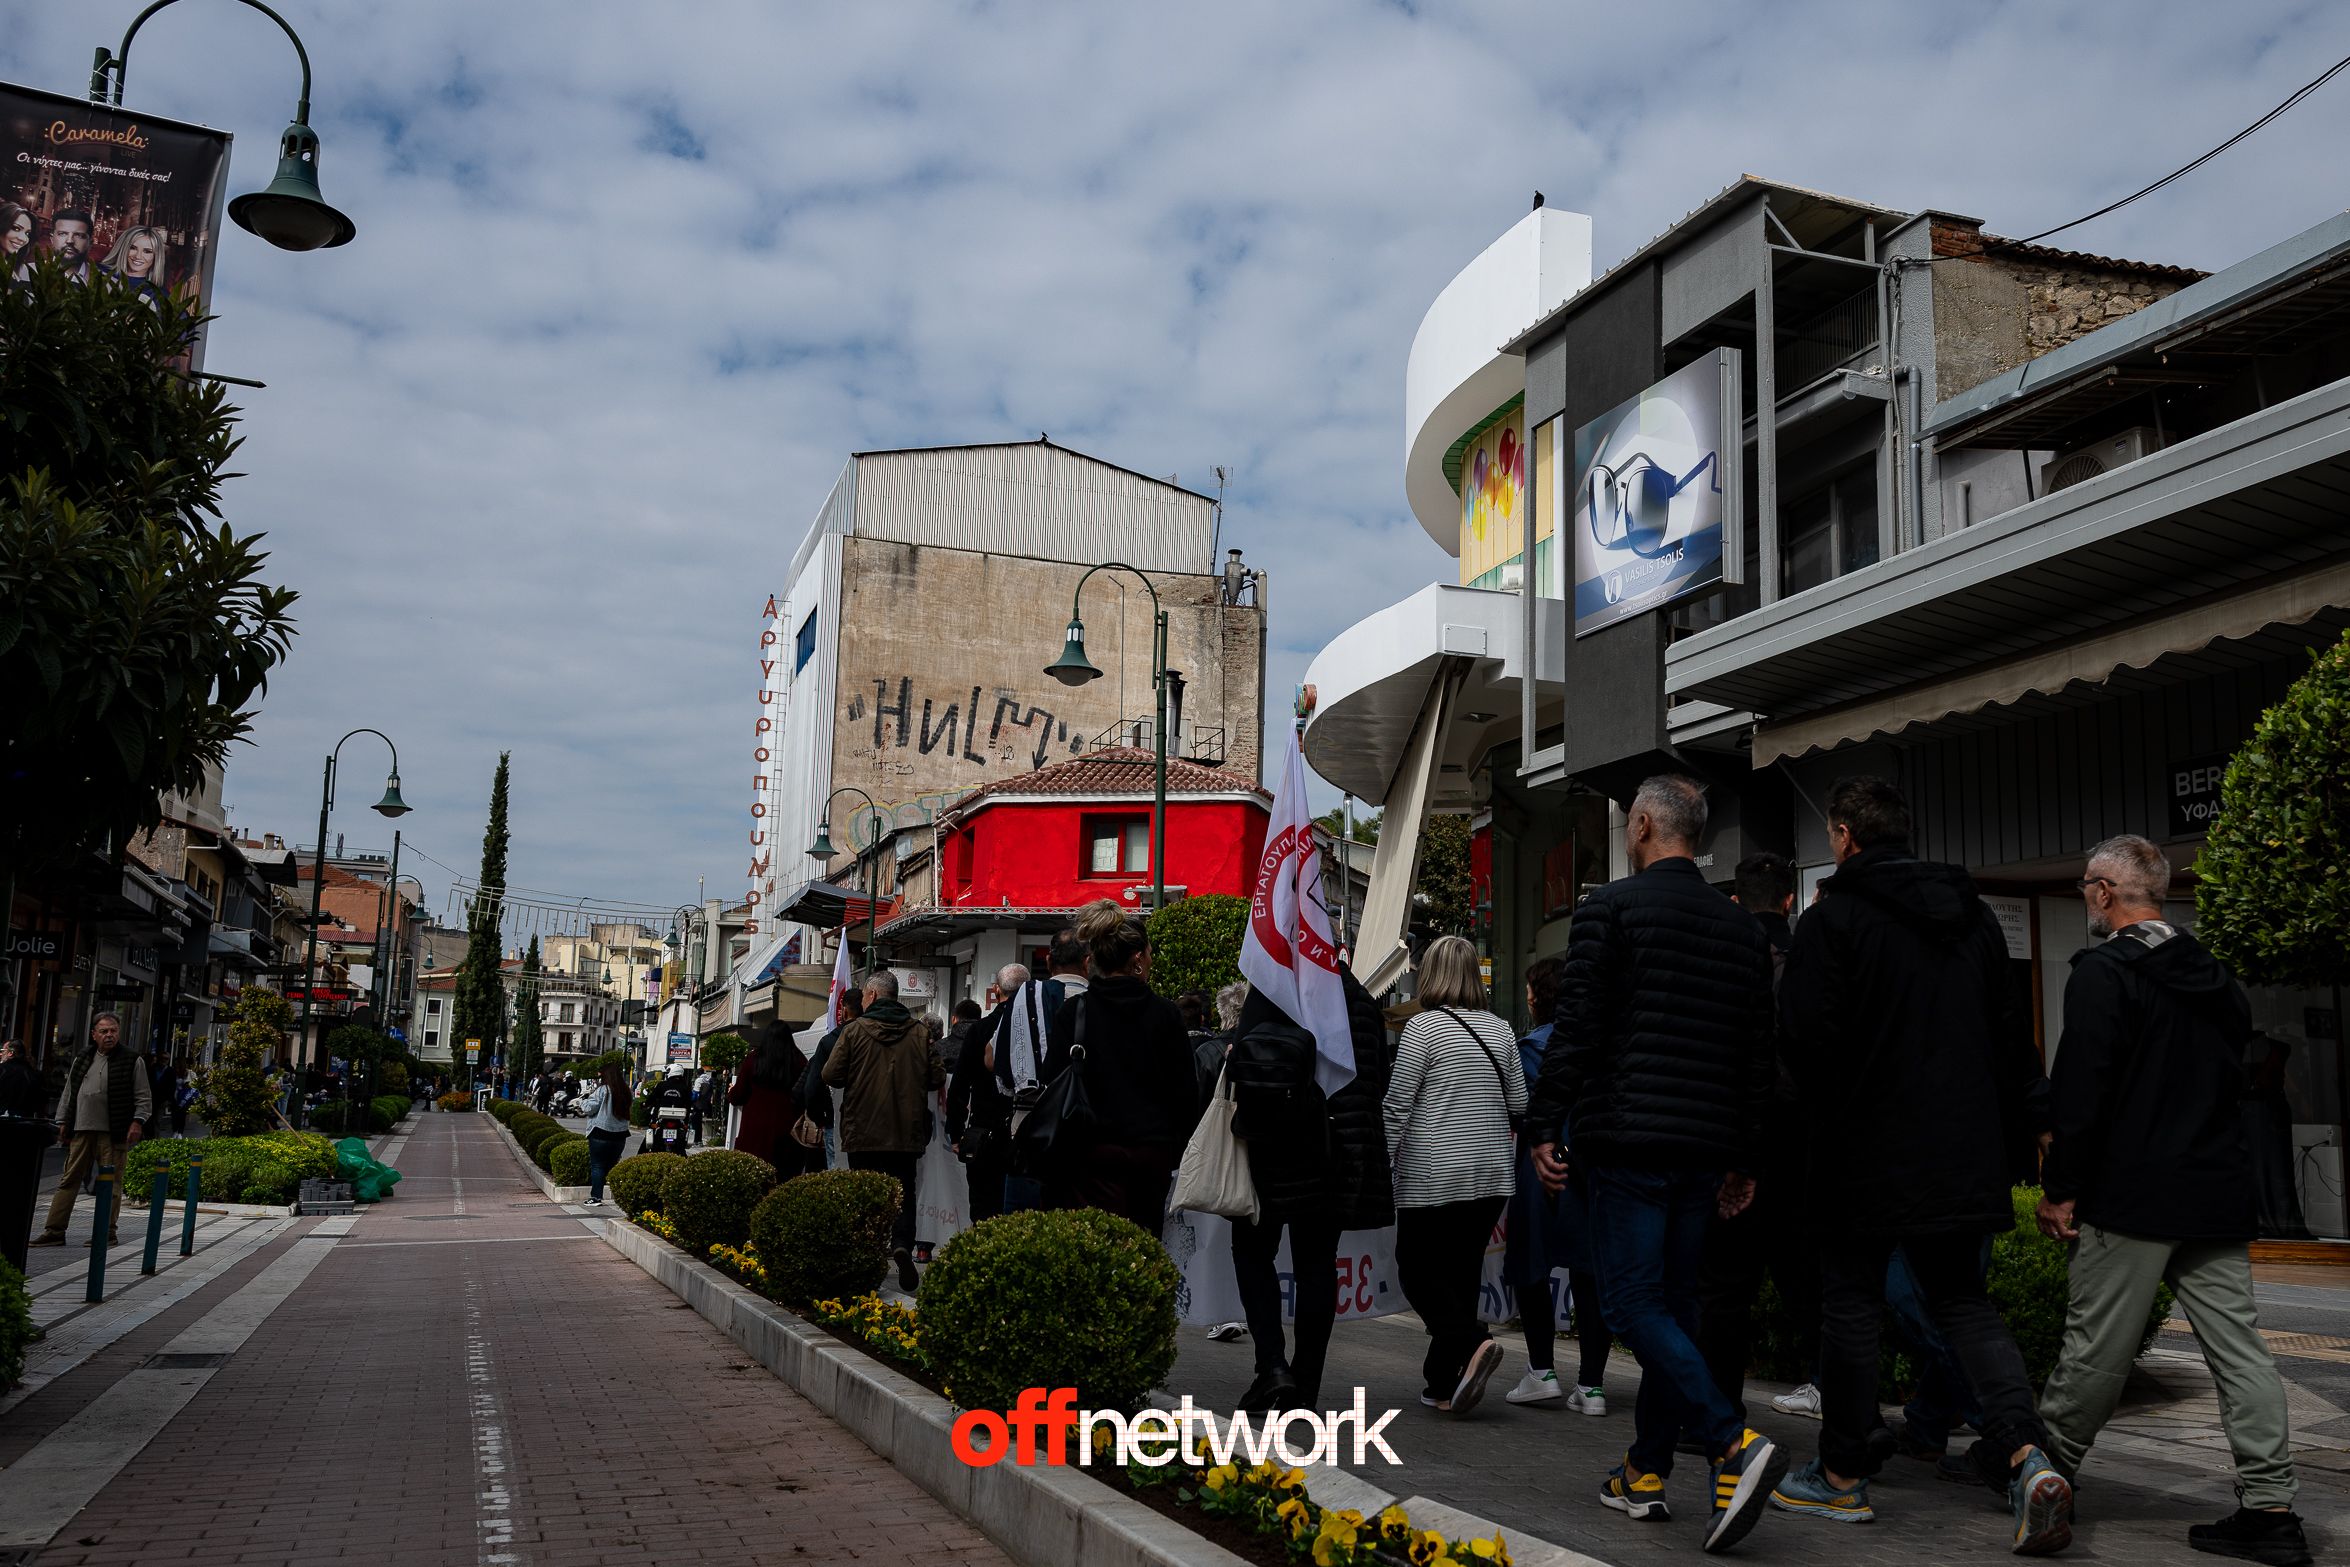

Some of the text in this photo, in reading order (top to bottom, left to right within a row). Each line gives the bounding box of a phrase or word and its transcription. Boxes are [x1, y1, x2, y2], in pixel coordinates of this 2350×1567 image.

[50, 120, 146, 149] Caramela
[16, 152, 31, 163] Οι
[33, 156, 64, 169] νύχτες
[90, 163, 127, 177] γίνονται
[128, 168, 150, 180] δικές
[1624, 561, 1654, 583] VASILIS
[1655, 547, 1684, 569] TSOLIS
[6, 935, 57, 954] Jolie
